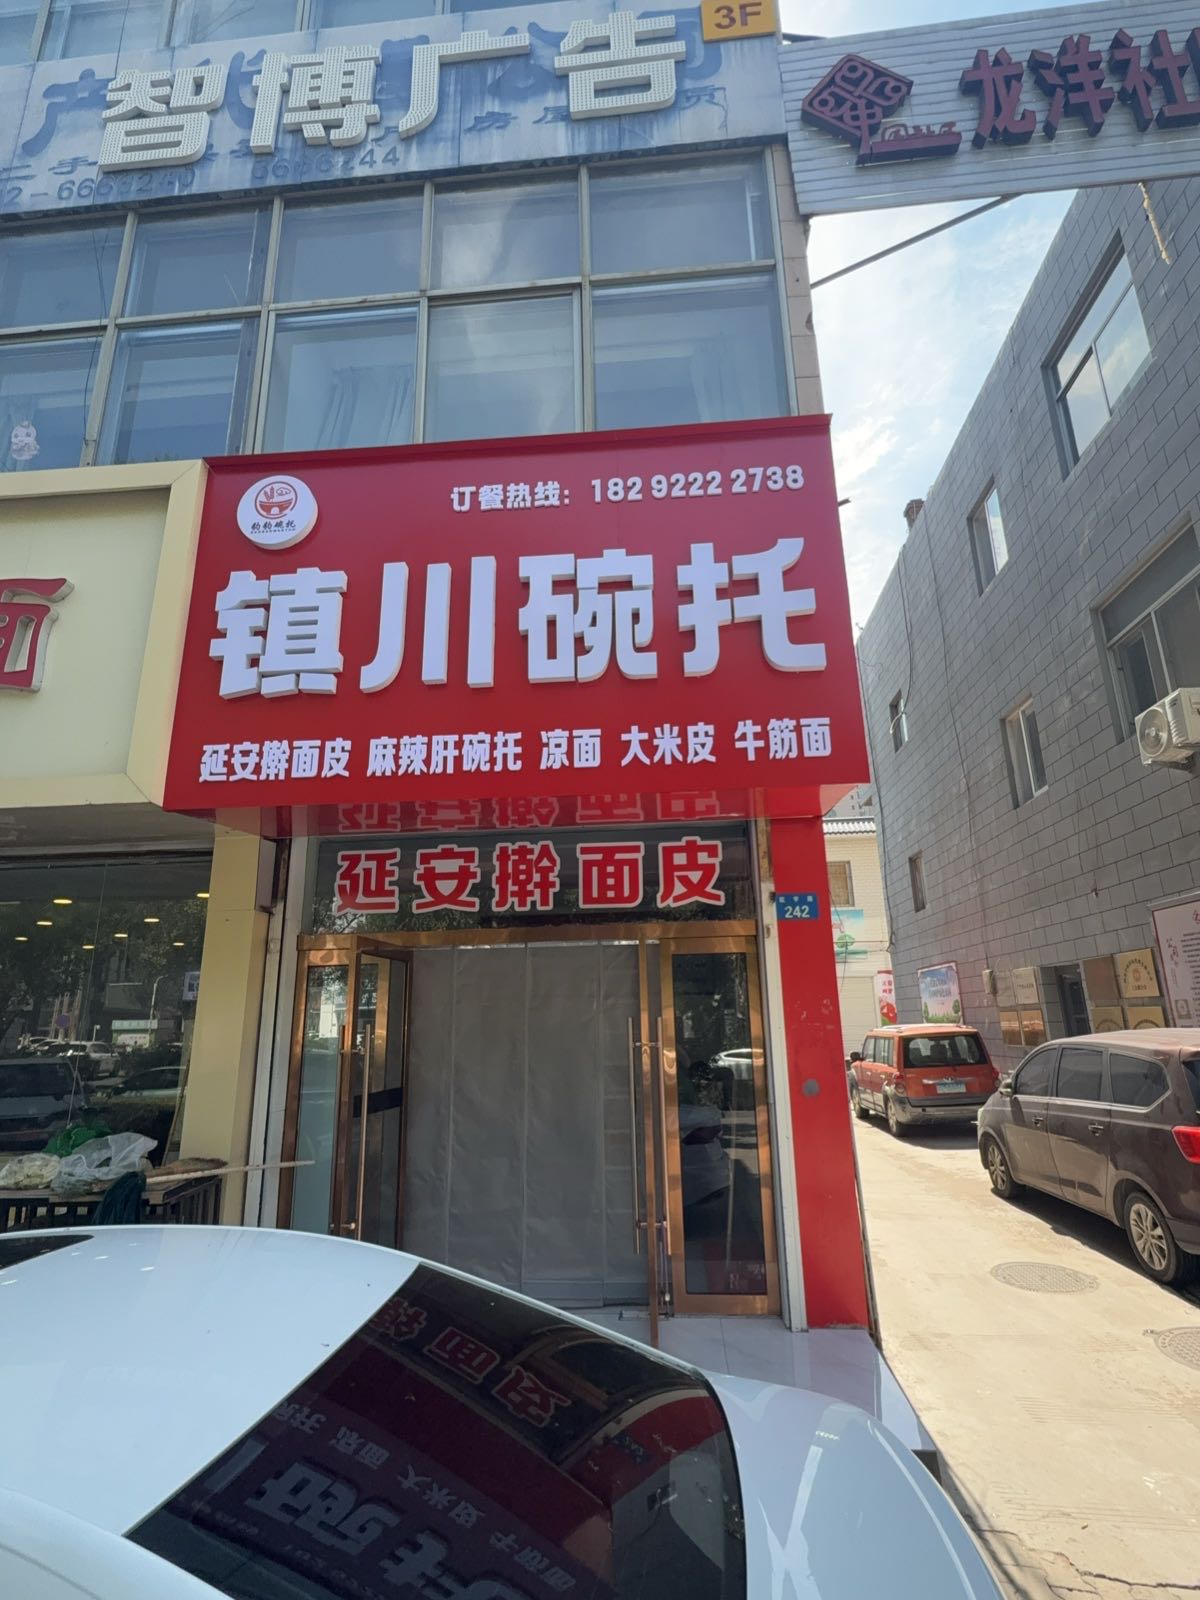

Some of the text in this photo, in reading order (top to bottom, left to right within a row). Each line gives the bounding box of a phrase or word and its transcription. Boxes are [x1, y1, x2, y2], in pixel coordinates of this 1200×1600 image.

[714, 2, 762, 29] 3F
[100, 9, 688, 172] 智博广告
[959, 26, 1200, 149] 龙洋社
[451, 464, 805, 512] 订餐热线： 182 9222 2738
[209, 537, 828, 699] 镇川碗托
[199, 716, 832, 783] 延安擀面皮 麻辣肝碗托 凉面 大米皮 牛筋面
[335, 836, 726, 915] 延安擀面皮
[784, 905, 811, 918] 242
